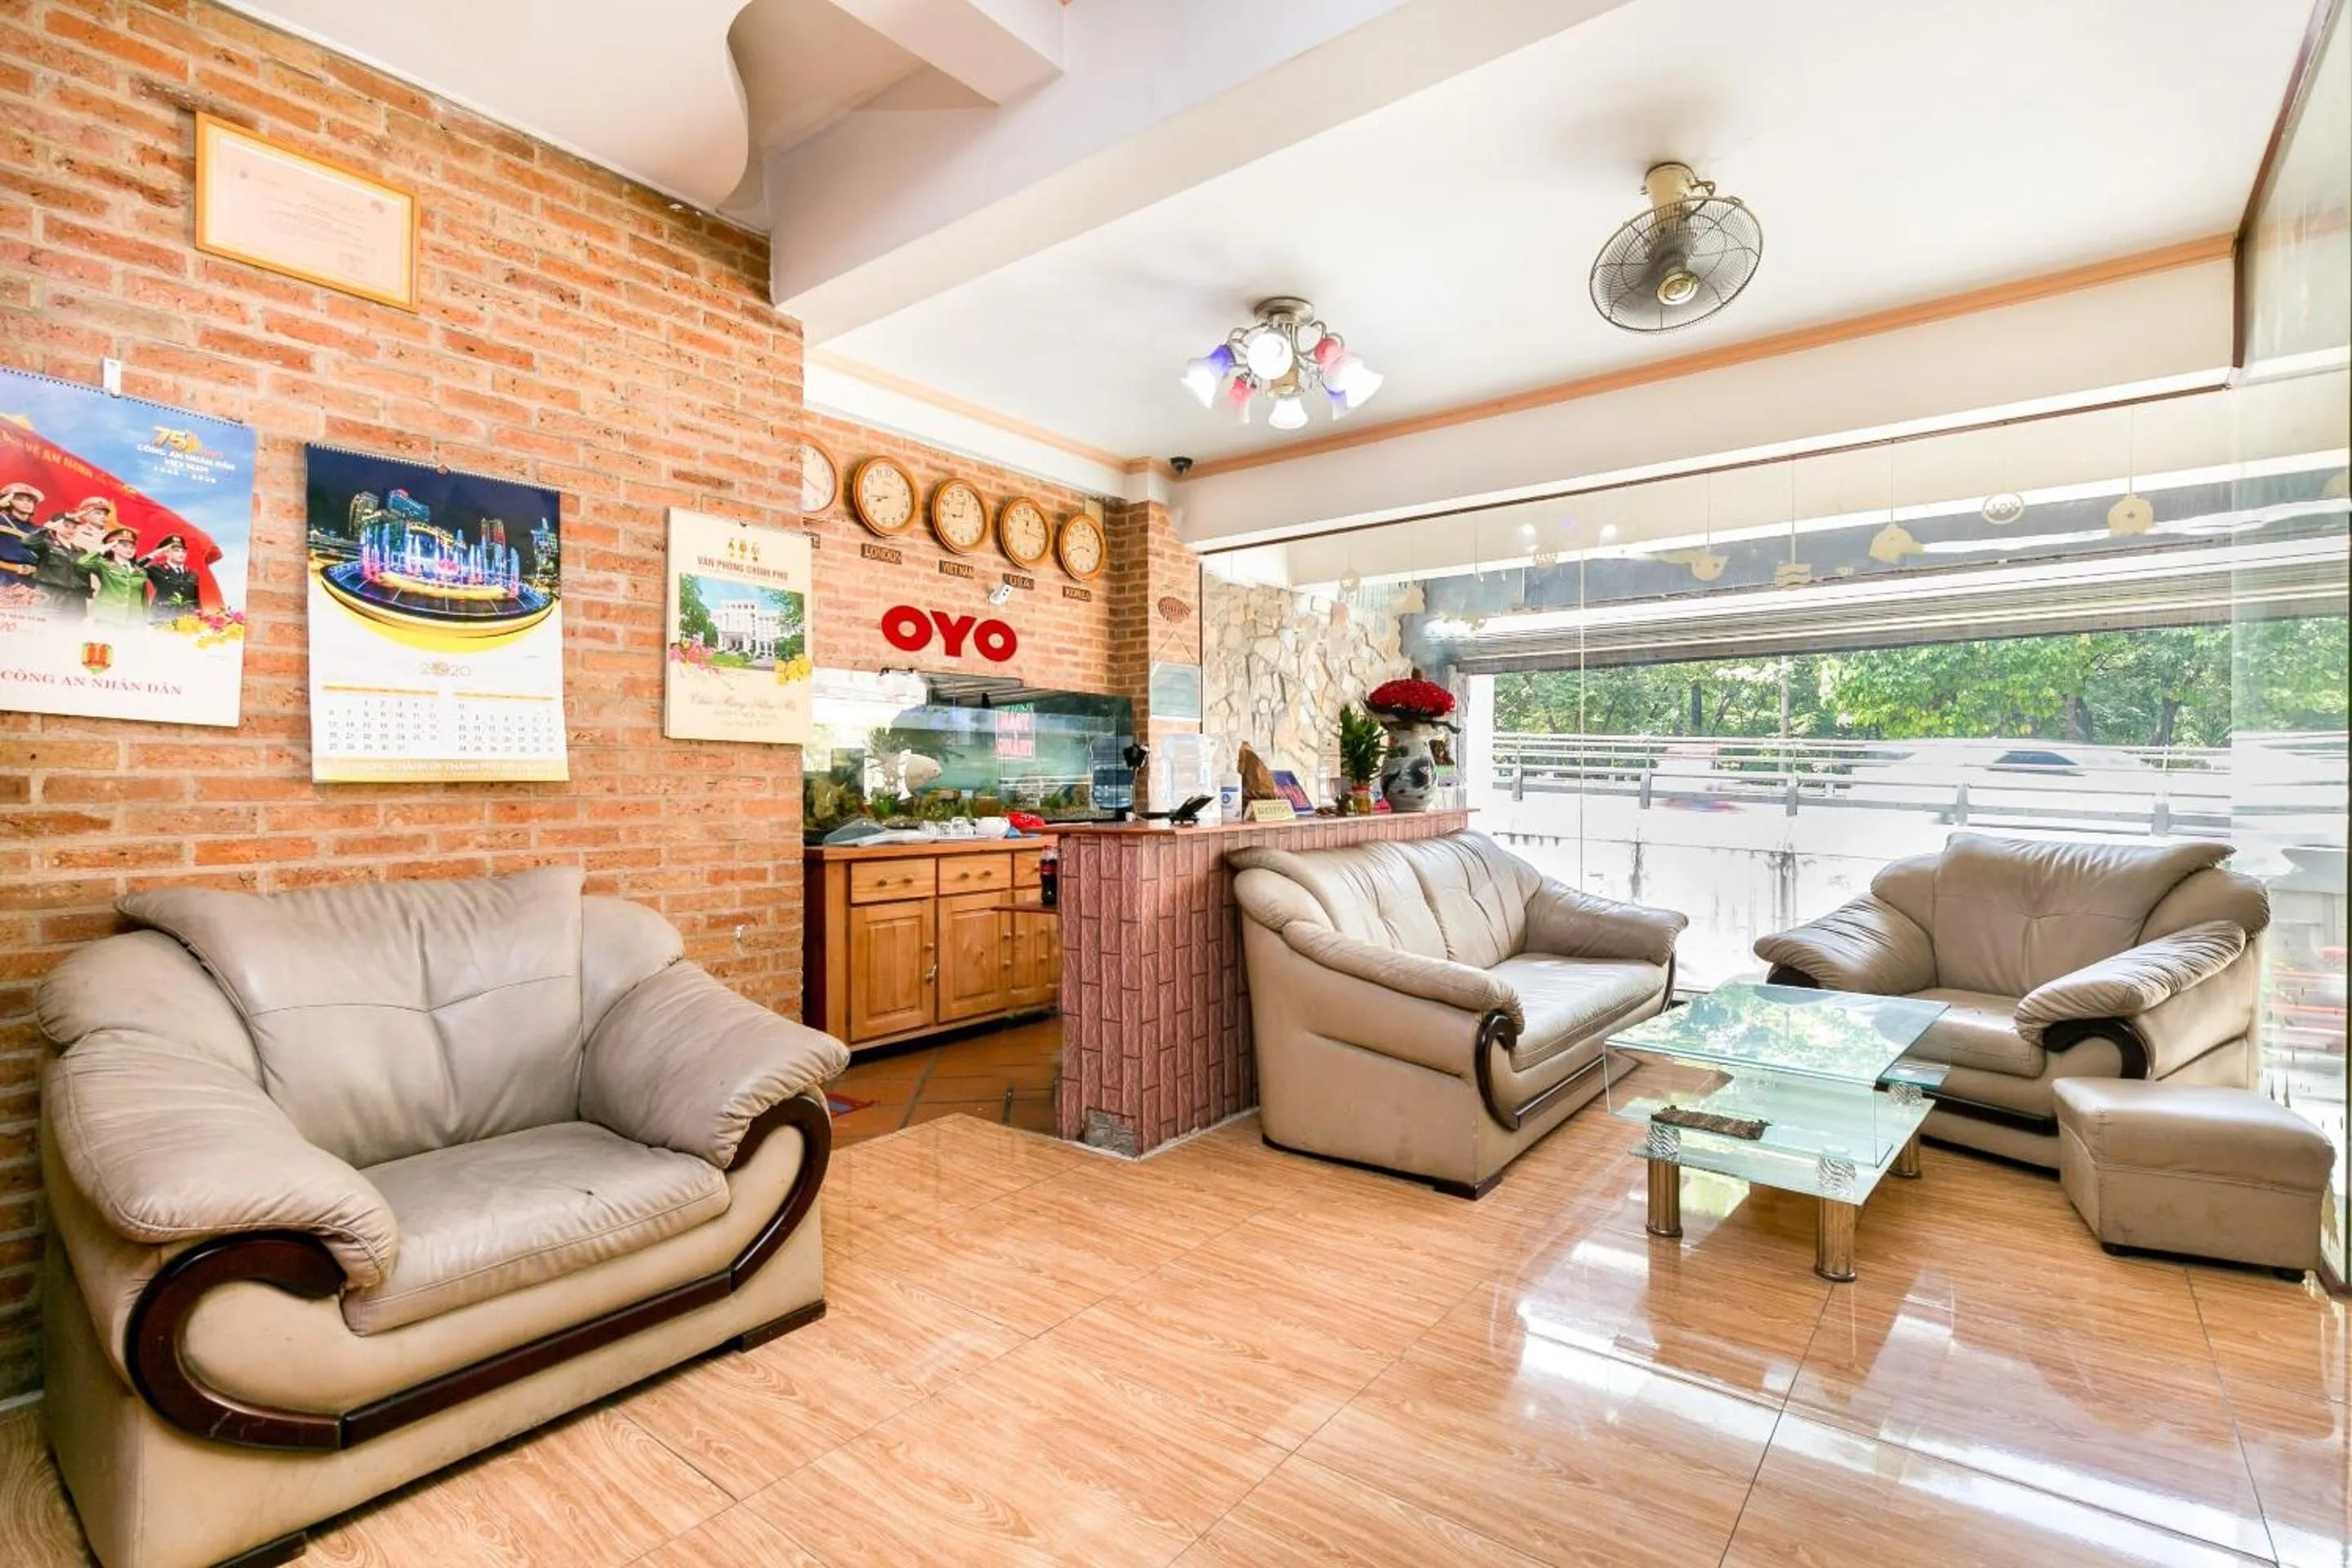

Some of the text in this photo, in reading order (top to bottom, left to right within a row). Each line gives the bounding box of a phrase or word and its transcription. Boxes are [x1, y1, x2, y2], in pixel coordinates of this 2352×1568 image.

[153, 425, 189, 451] 75
[865, 544, 902, 564] LONDON
[1009, 577, 1030, 589] USA
[880, 605, 1018, 662] OYO
[1, 668, 56, 684] CÔNG
[60, 675, 86, 688] AN
